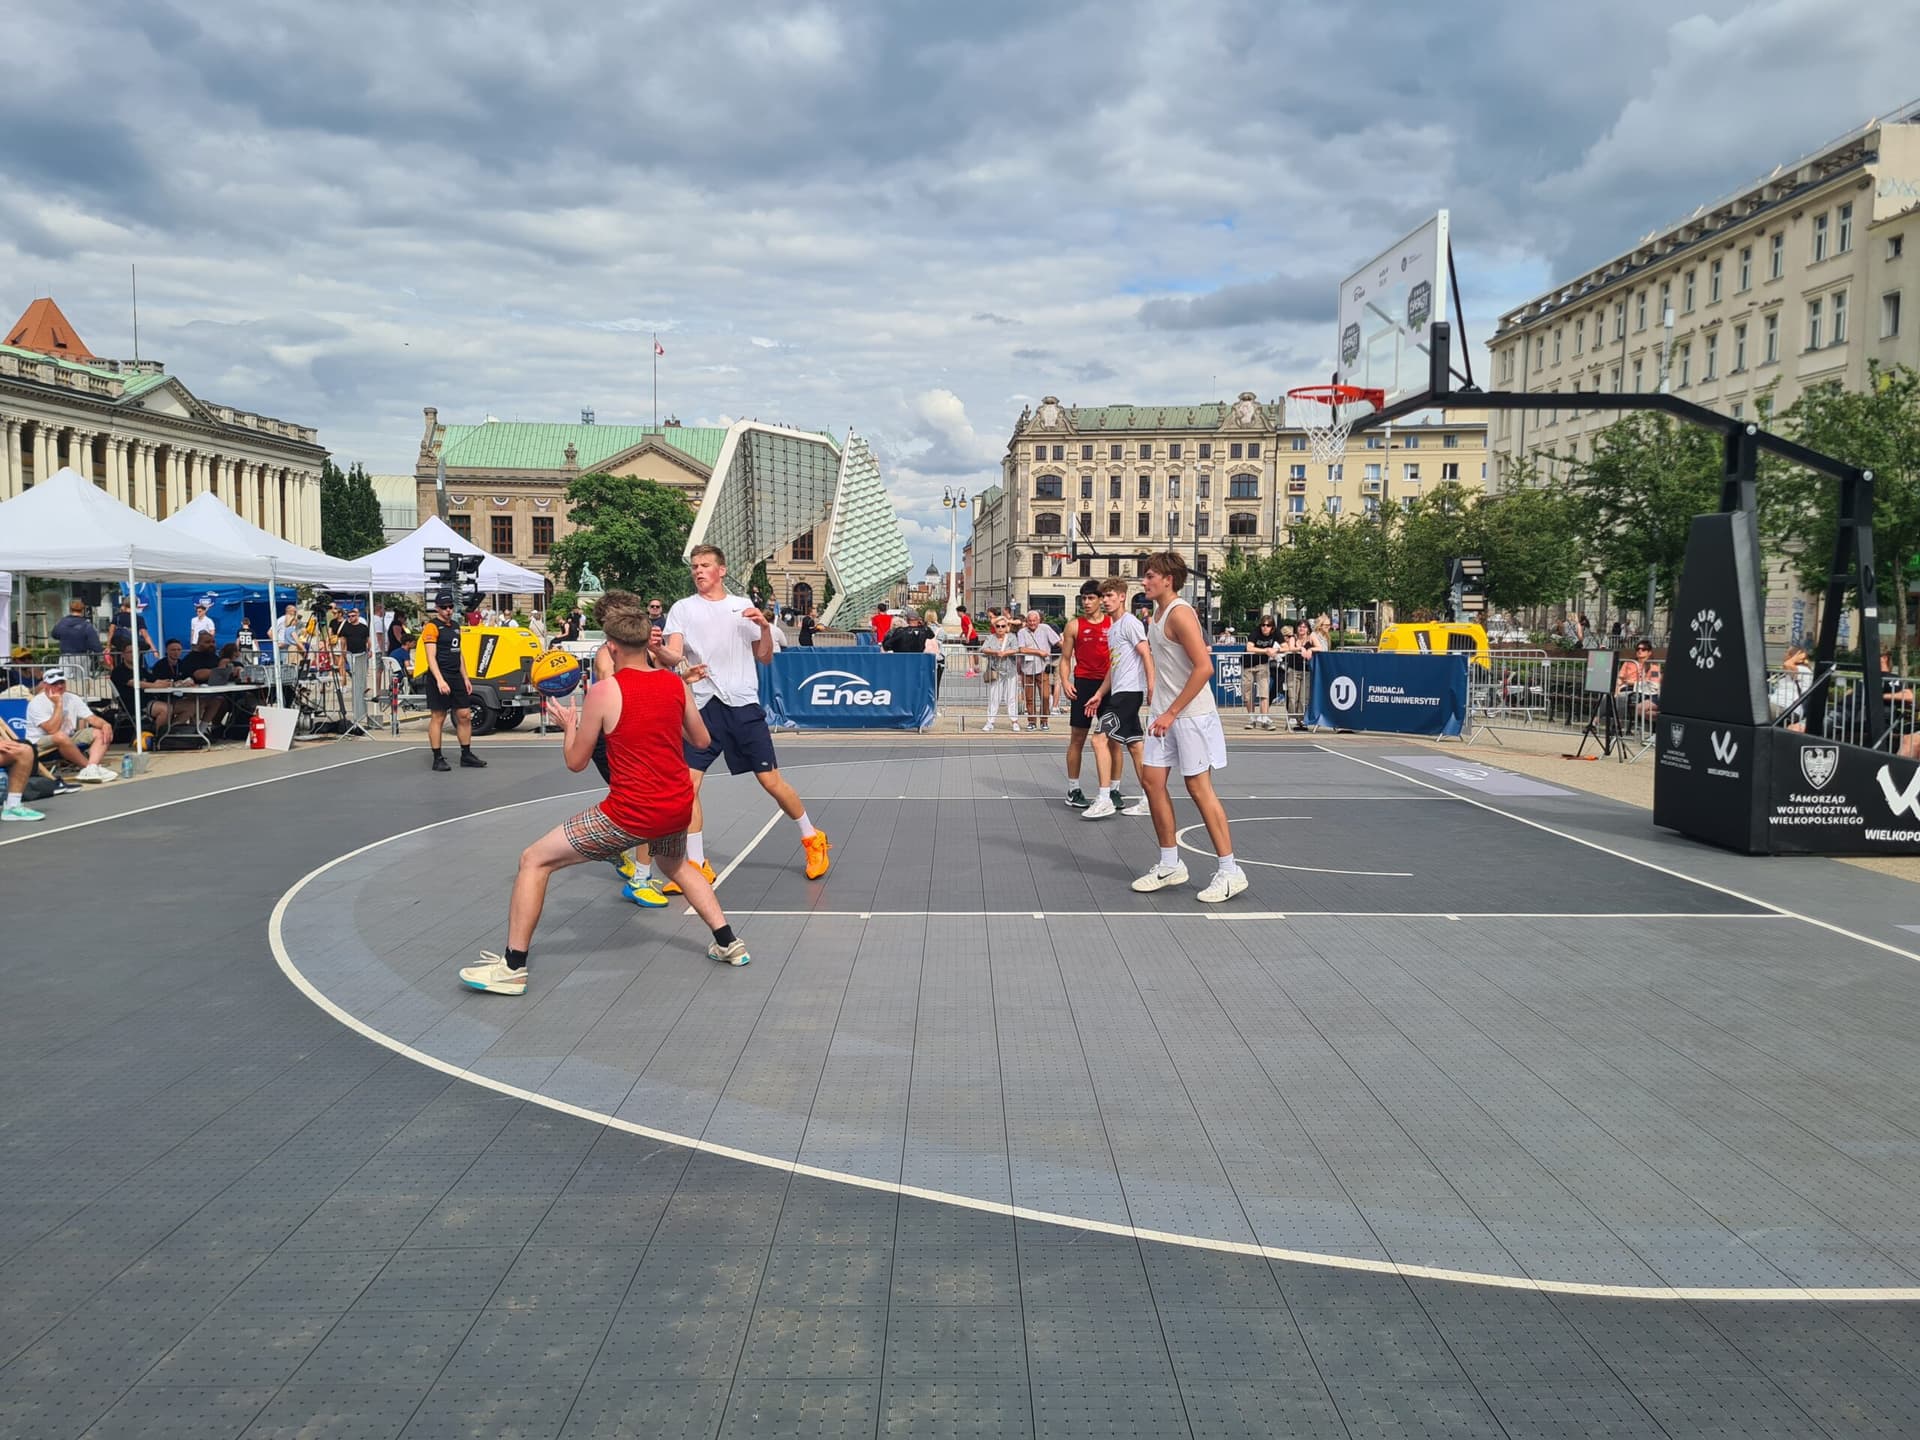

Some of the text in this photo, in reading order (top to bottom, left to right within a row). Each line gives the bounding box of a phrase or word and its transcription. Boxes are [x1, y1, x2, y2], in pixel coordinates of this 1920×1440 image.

[1083, 501, 1207, 510] BAZAR
[811, 684, 892, 705] Enea
[1368, 685, 1404, 694] FUNDACJA
[1366, 695, 1440, 706] JEDEN UNIWERSYTET
[1788, 793, 1846, 804] SAMORZĄD
[1776, 804, 1858, 814] WOJEWÓDZTWA
[1768, 816, 1864, 825] WIELKOPOLSKIEGO
